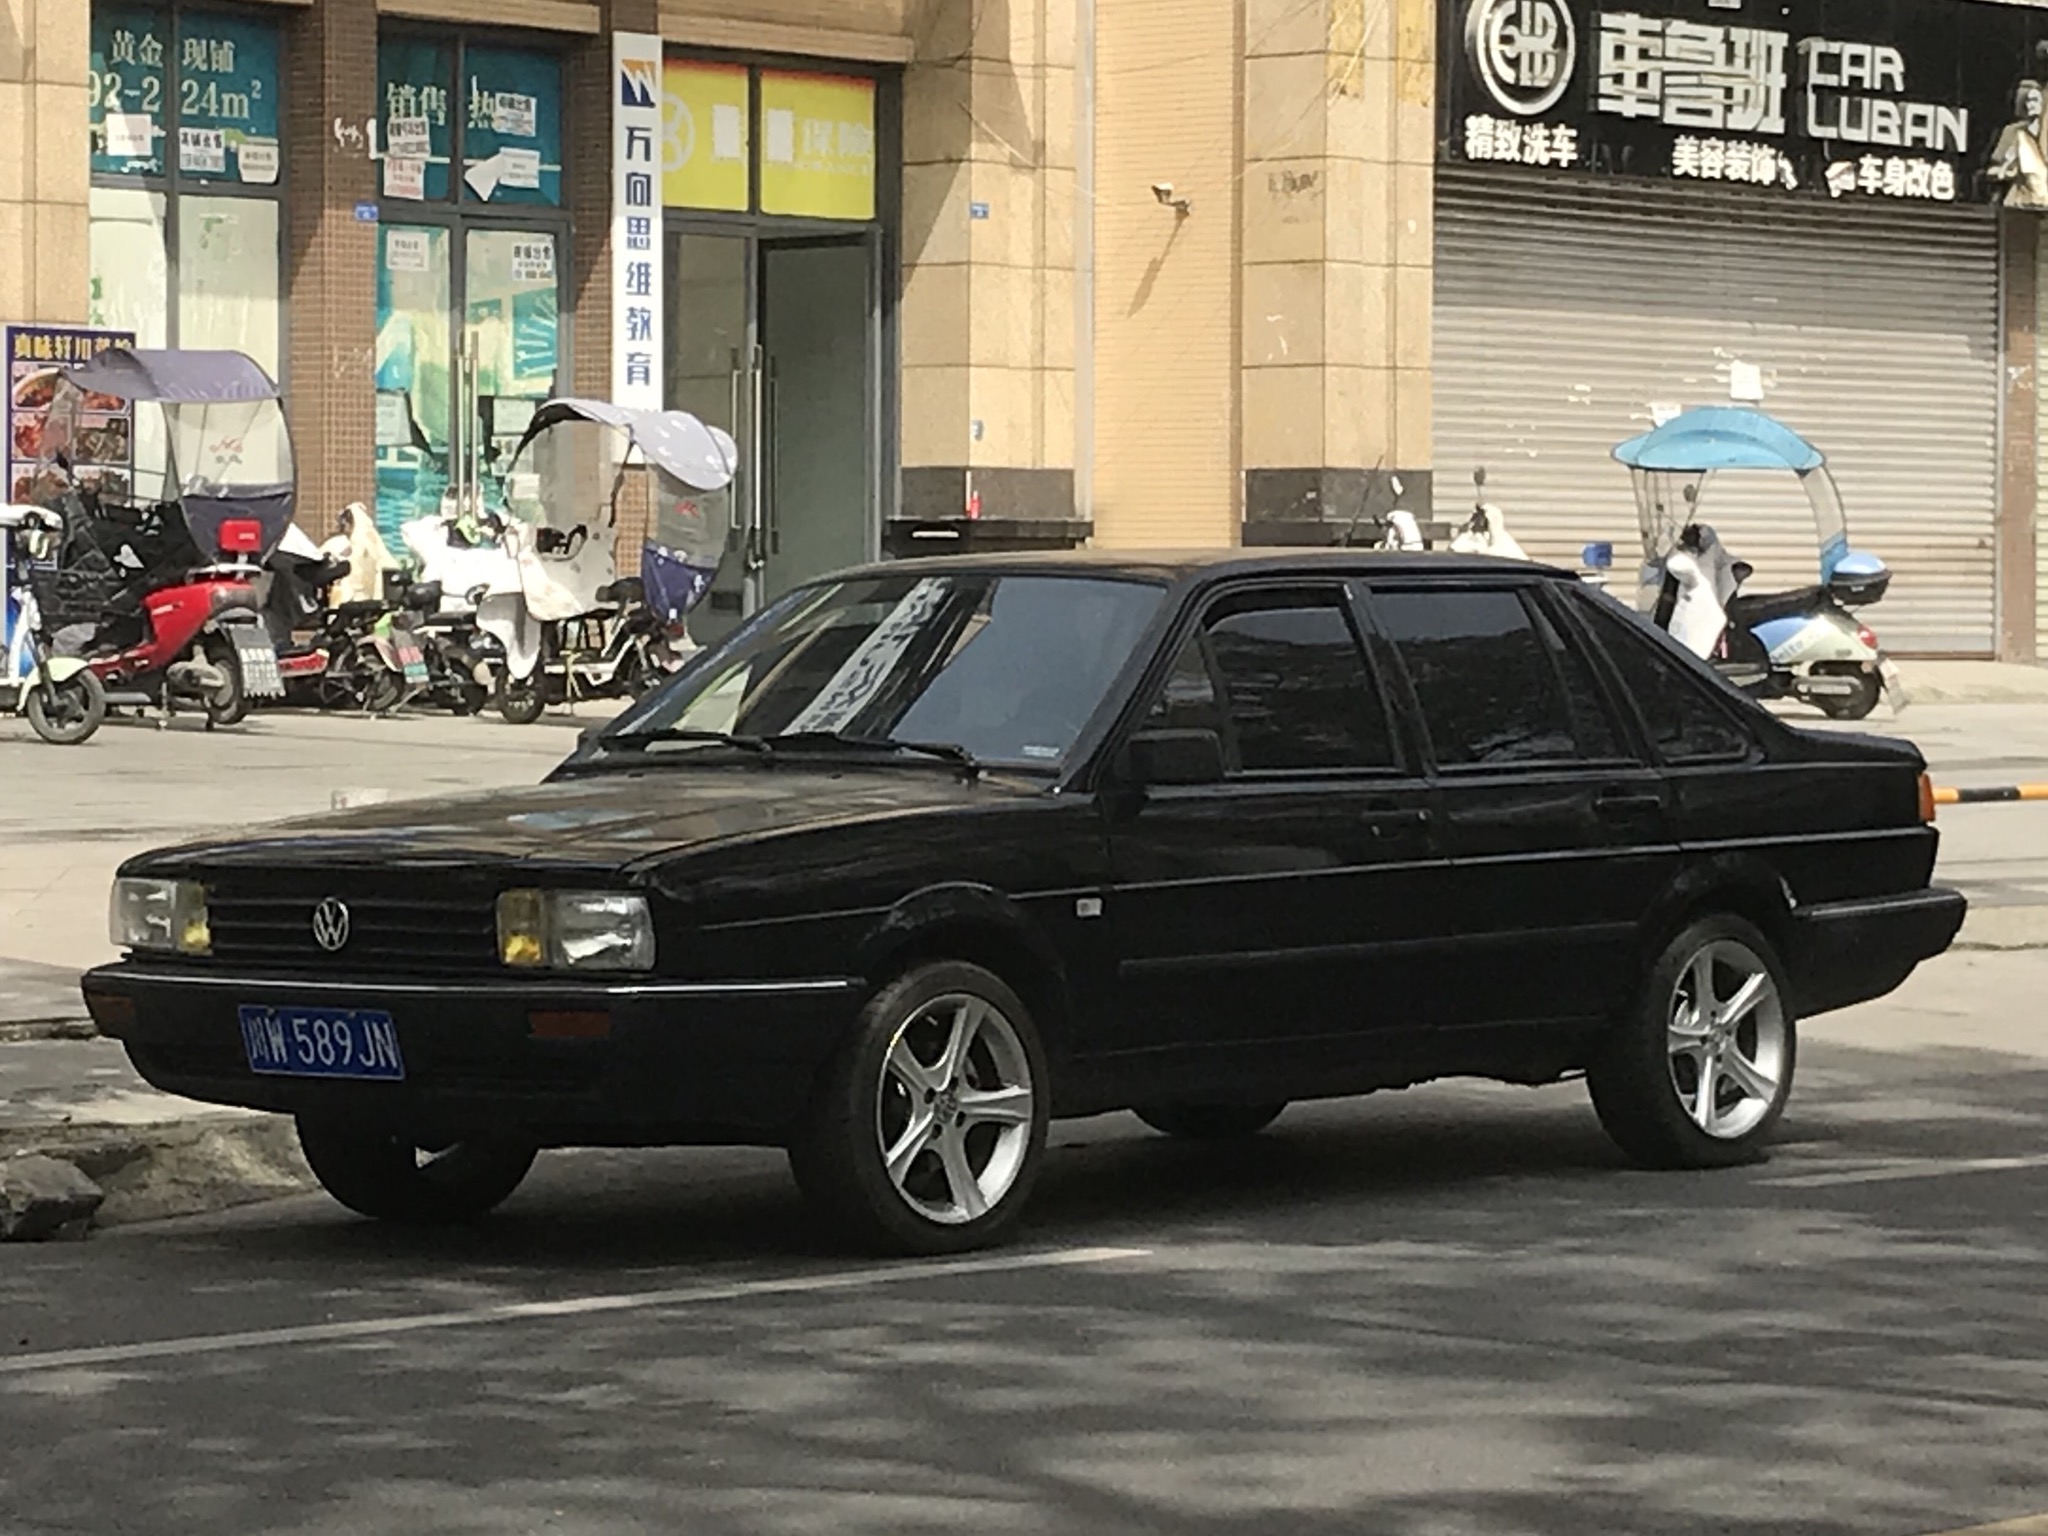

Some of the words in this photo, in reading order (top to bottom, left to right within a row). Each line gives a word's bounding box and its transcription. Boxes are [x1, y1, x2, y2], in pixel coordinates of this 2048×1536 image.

[110, 30, 164, 68] 黄金
[182, 38, 235, 73] 现铺
[1807, 41, 1905, 92] CAR
[386, 82, 447, 126] 销售
[1807, 90, 1968, 152] LUBAN
[1464, 113, 1578, 168] 精致洗车
[1857, 153, 1955, 200] 车身改色
[625, 125, 653, 386] 万向思维教育
